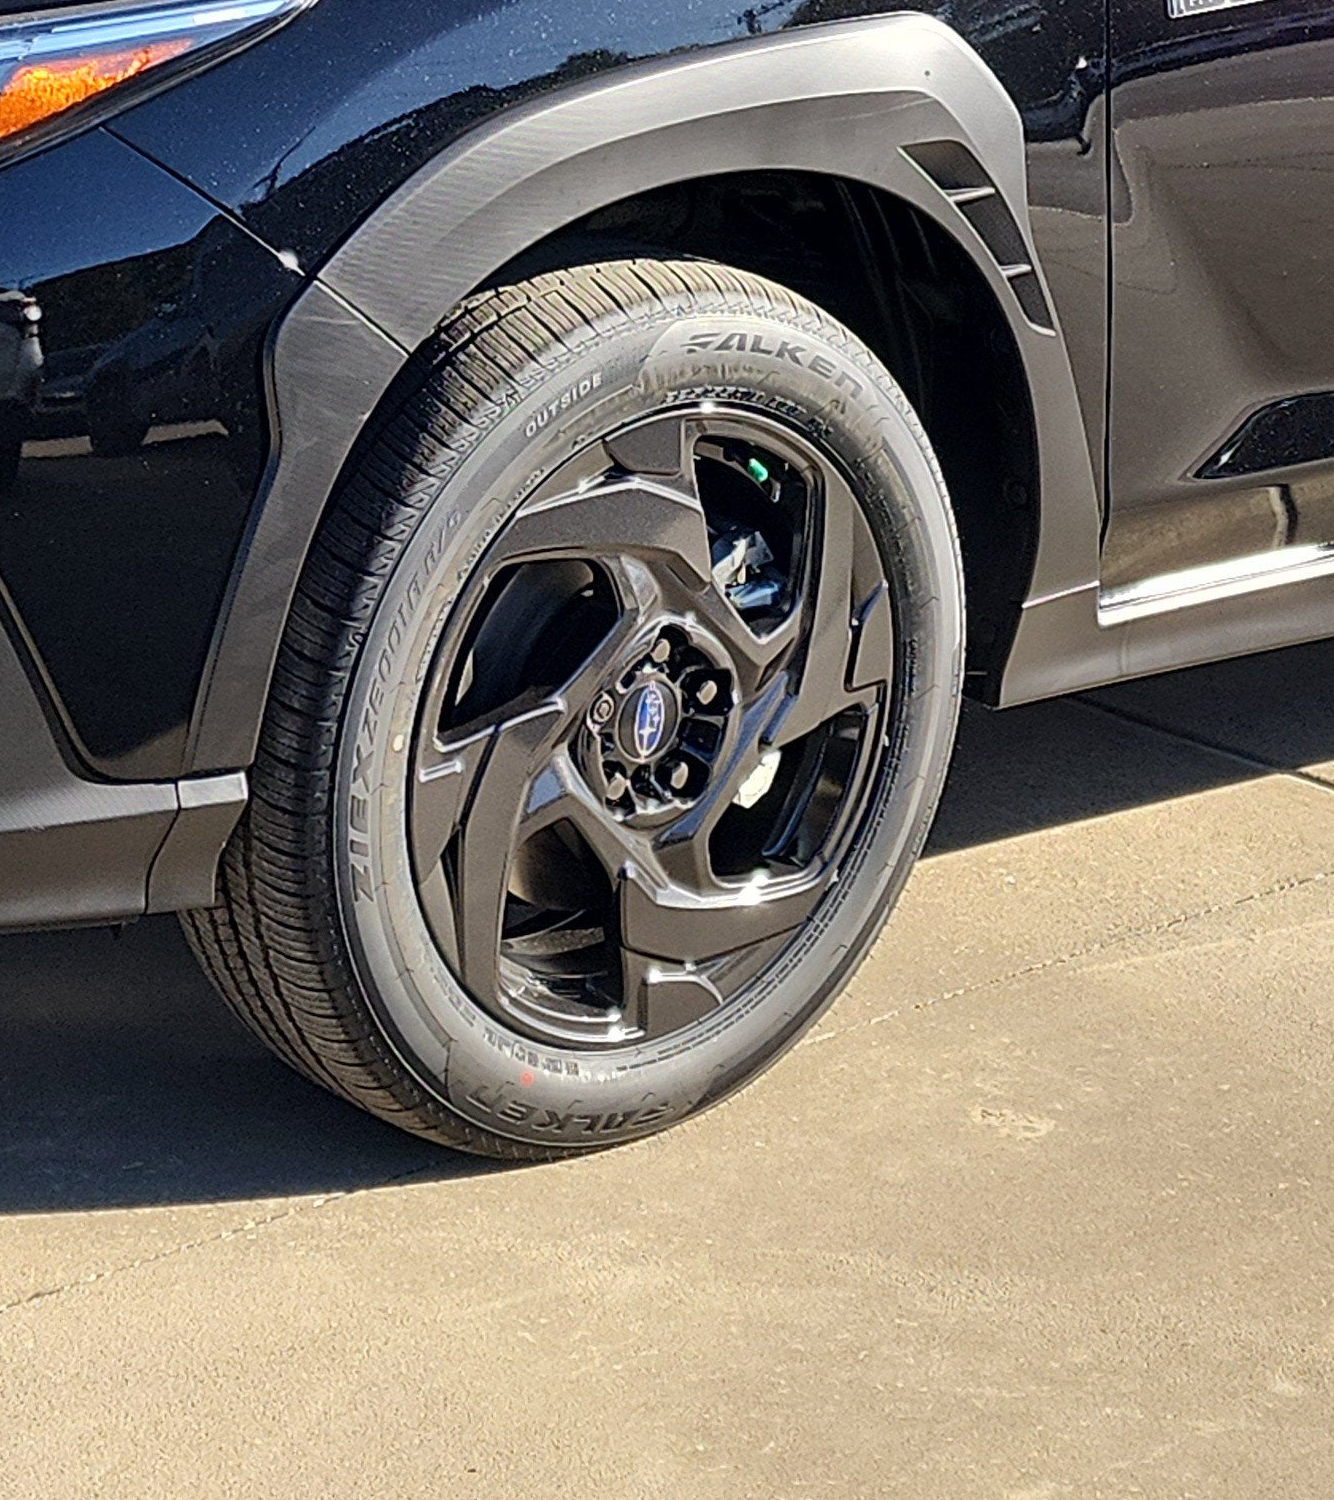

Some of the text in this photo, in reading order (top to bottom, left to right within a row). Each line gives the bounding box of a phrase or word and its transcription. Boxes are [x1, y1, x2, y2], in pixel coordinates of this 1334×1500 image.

[681, 332, 864, 399] FALKEN
[525, 371, 603, 438] OUTSIDE
[349, 743, 375, 903] ZIEX
